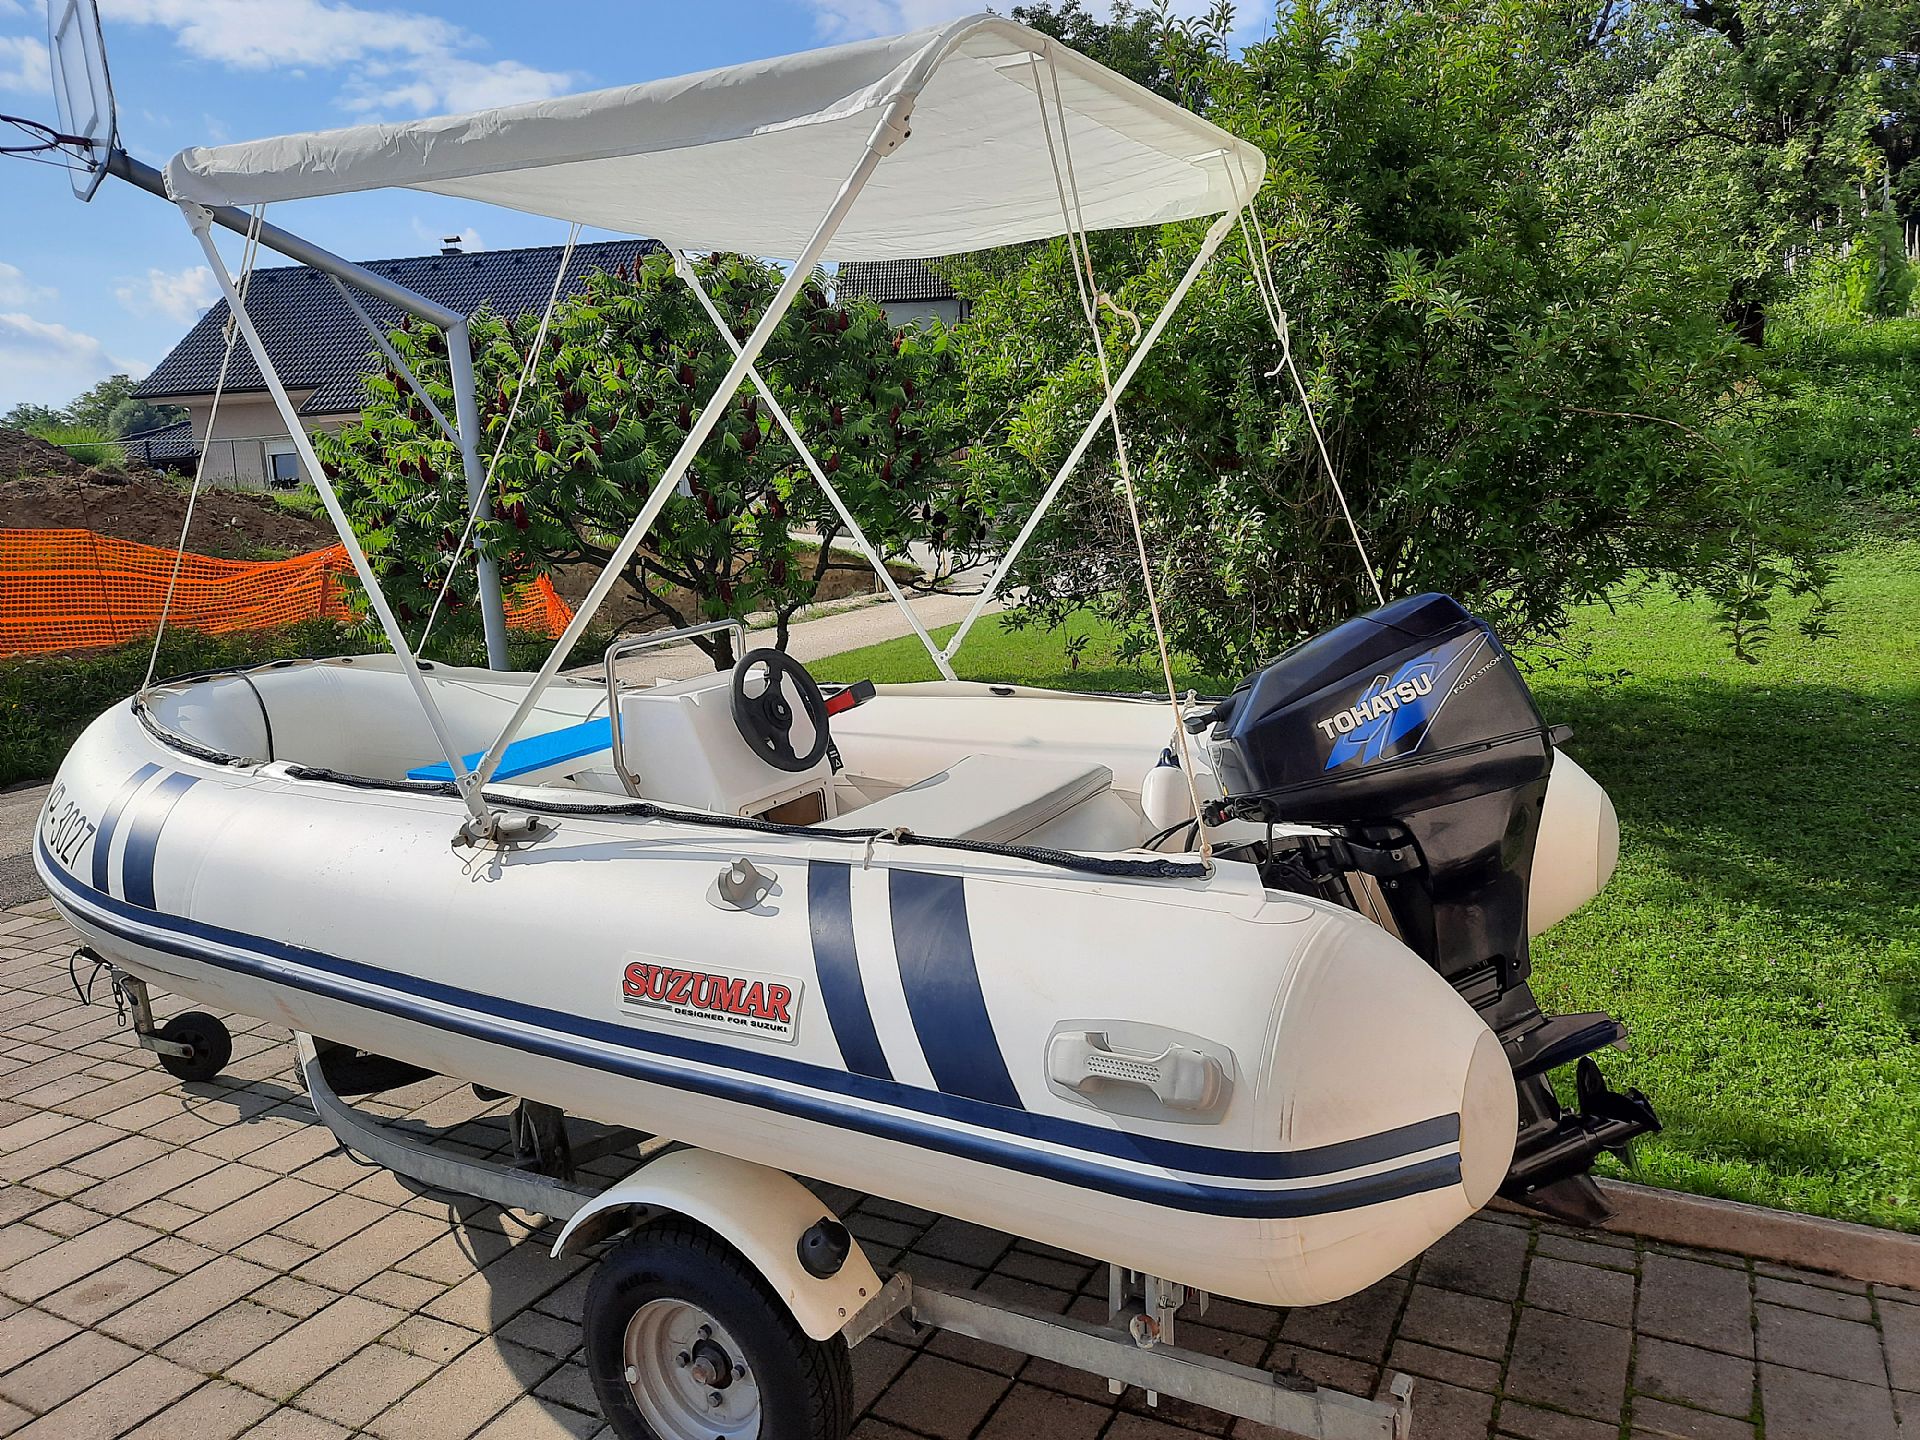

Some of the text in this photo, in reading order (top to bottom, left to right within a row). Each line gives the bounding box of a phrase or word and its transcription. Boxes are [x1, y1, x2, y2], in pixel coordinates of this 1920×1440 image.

[1453, 674, 1478, 694] FOUR
[1317, 672, 1434, 740] TOHATSU
[623, 962, 791, 1023] SUZUMAR
[674, 1007, 788, 1033] DESIGNED FOR SUZUKI
